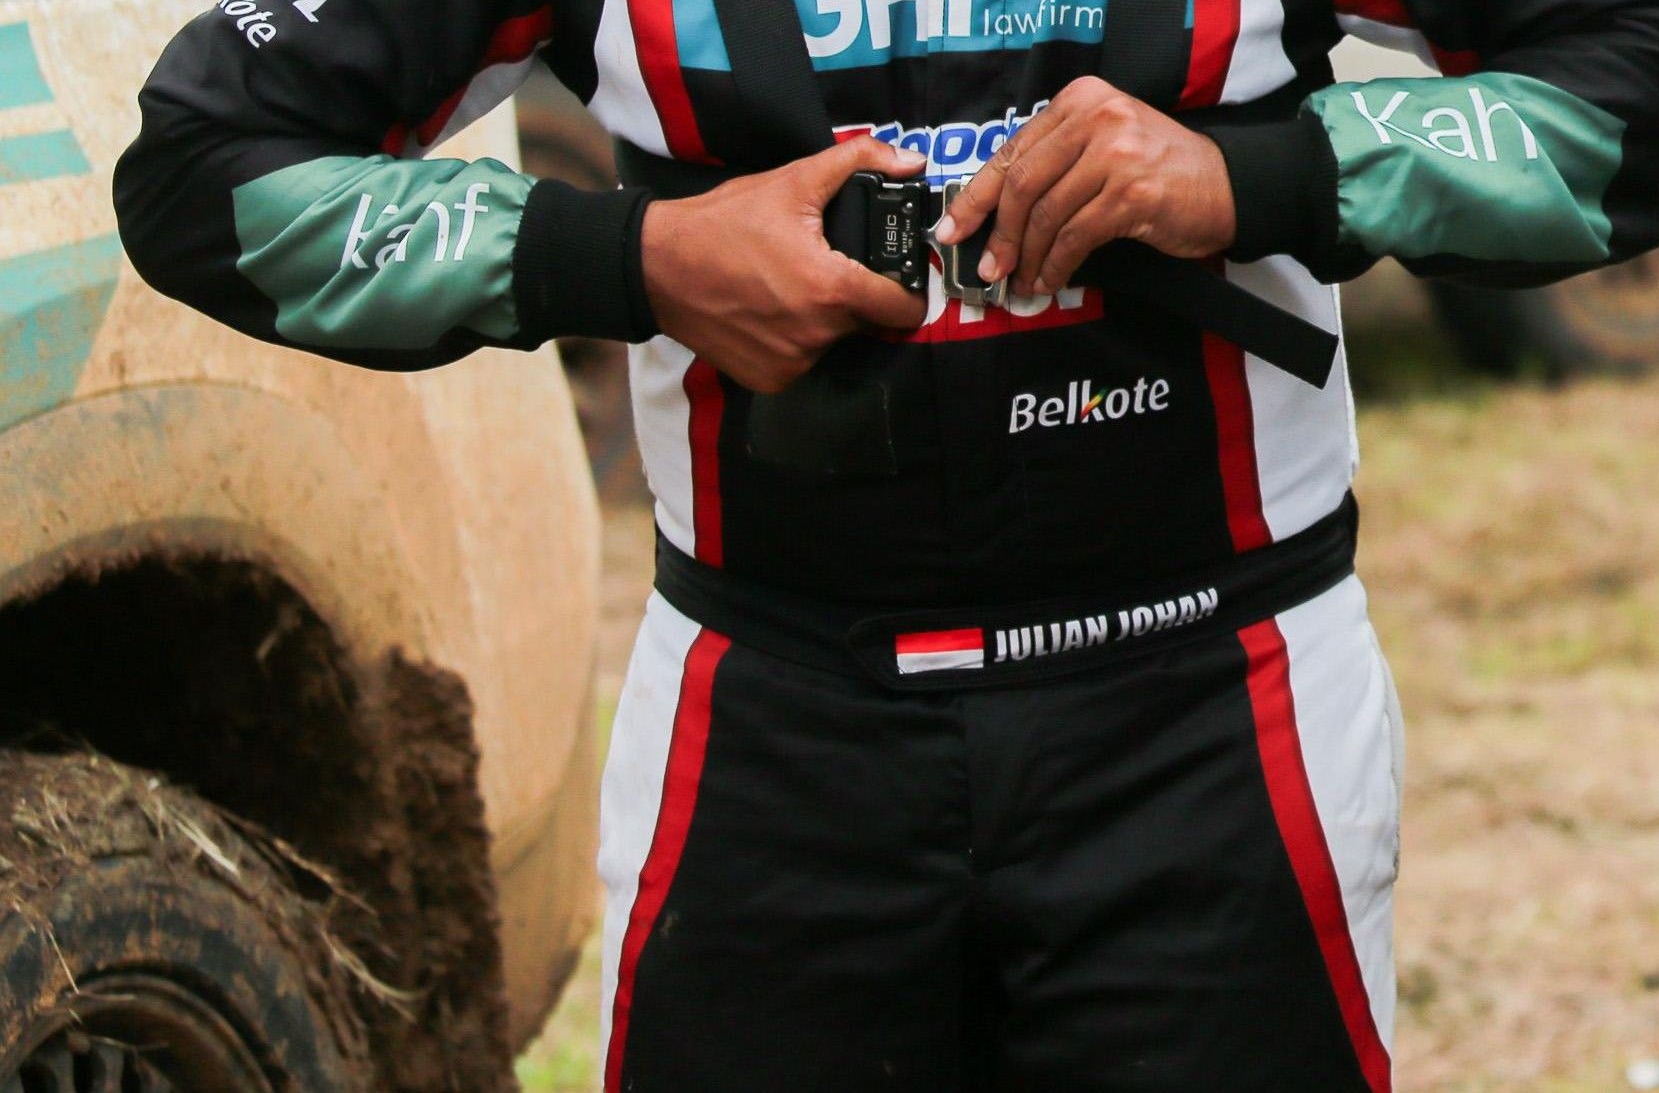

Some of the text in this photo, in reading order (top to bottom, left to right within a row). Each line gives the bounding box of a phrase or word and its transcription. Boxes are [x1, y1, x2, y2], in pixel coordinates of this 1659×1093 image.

[1008, 377, 1171, 434] Belkote
[994, 587, 1219, 663] JULIAN JOHAN
